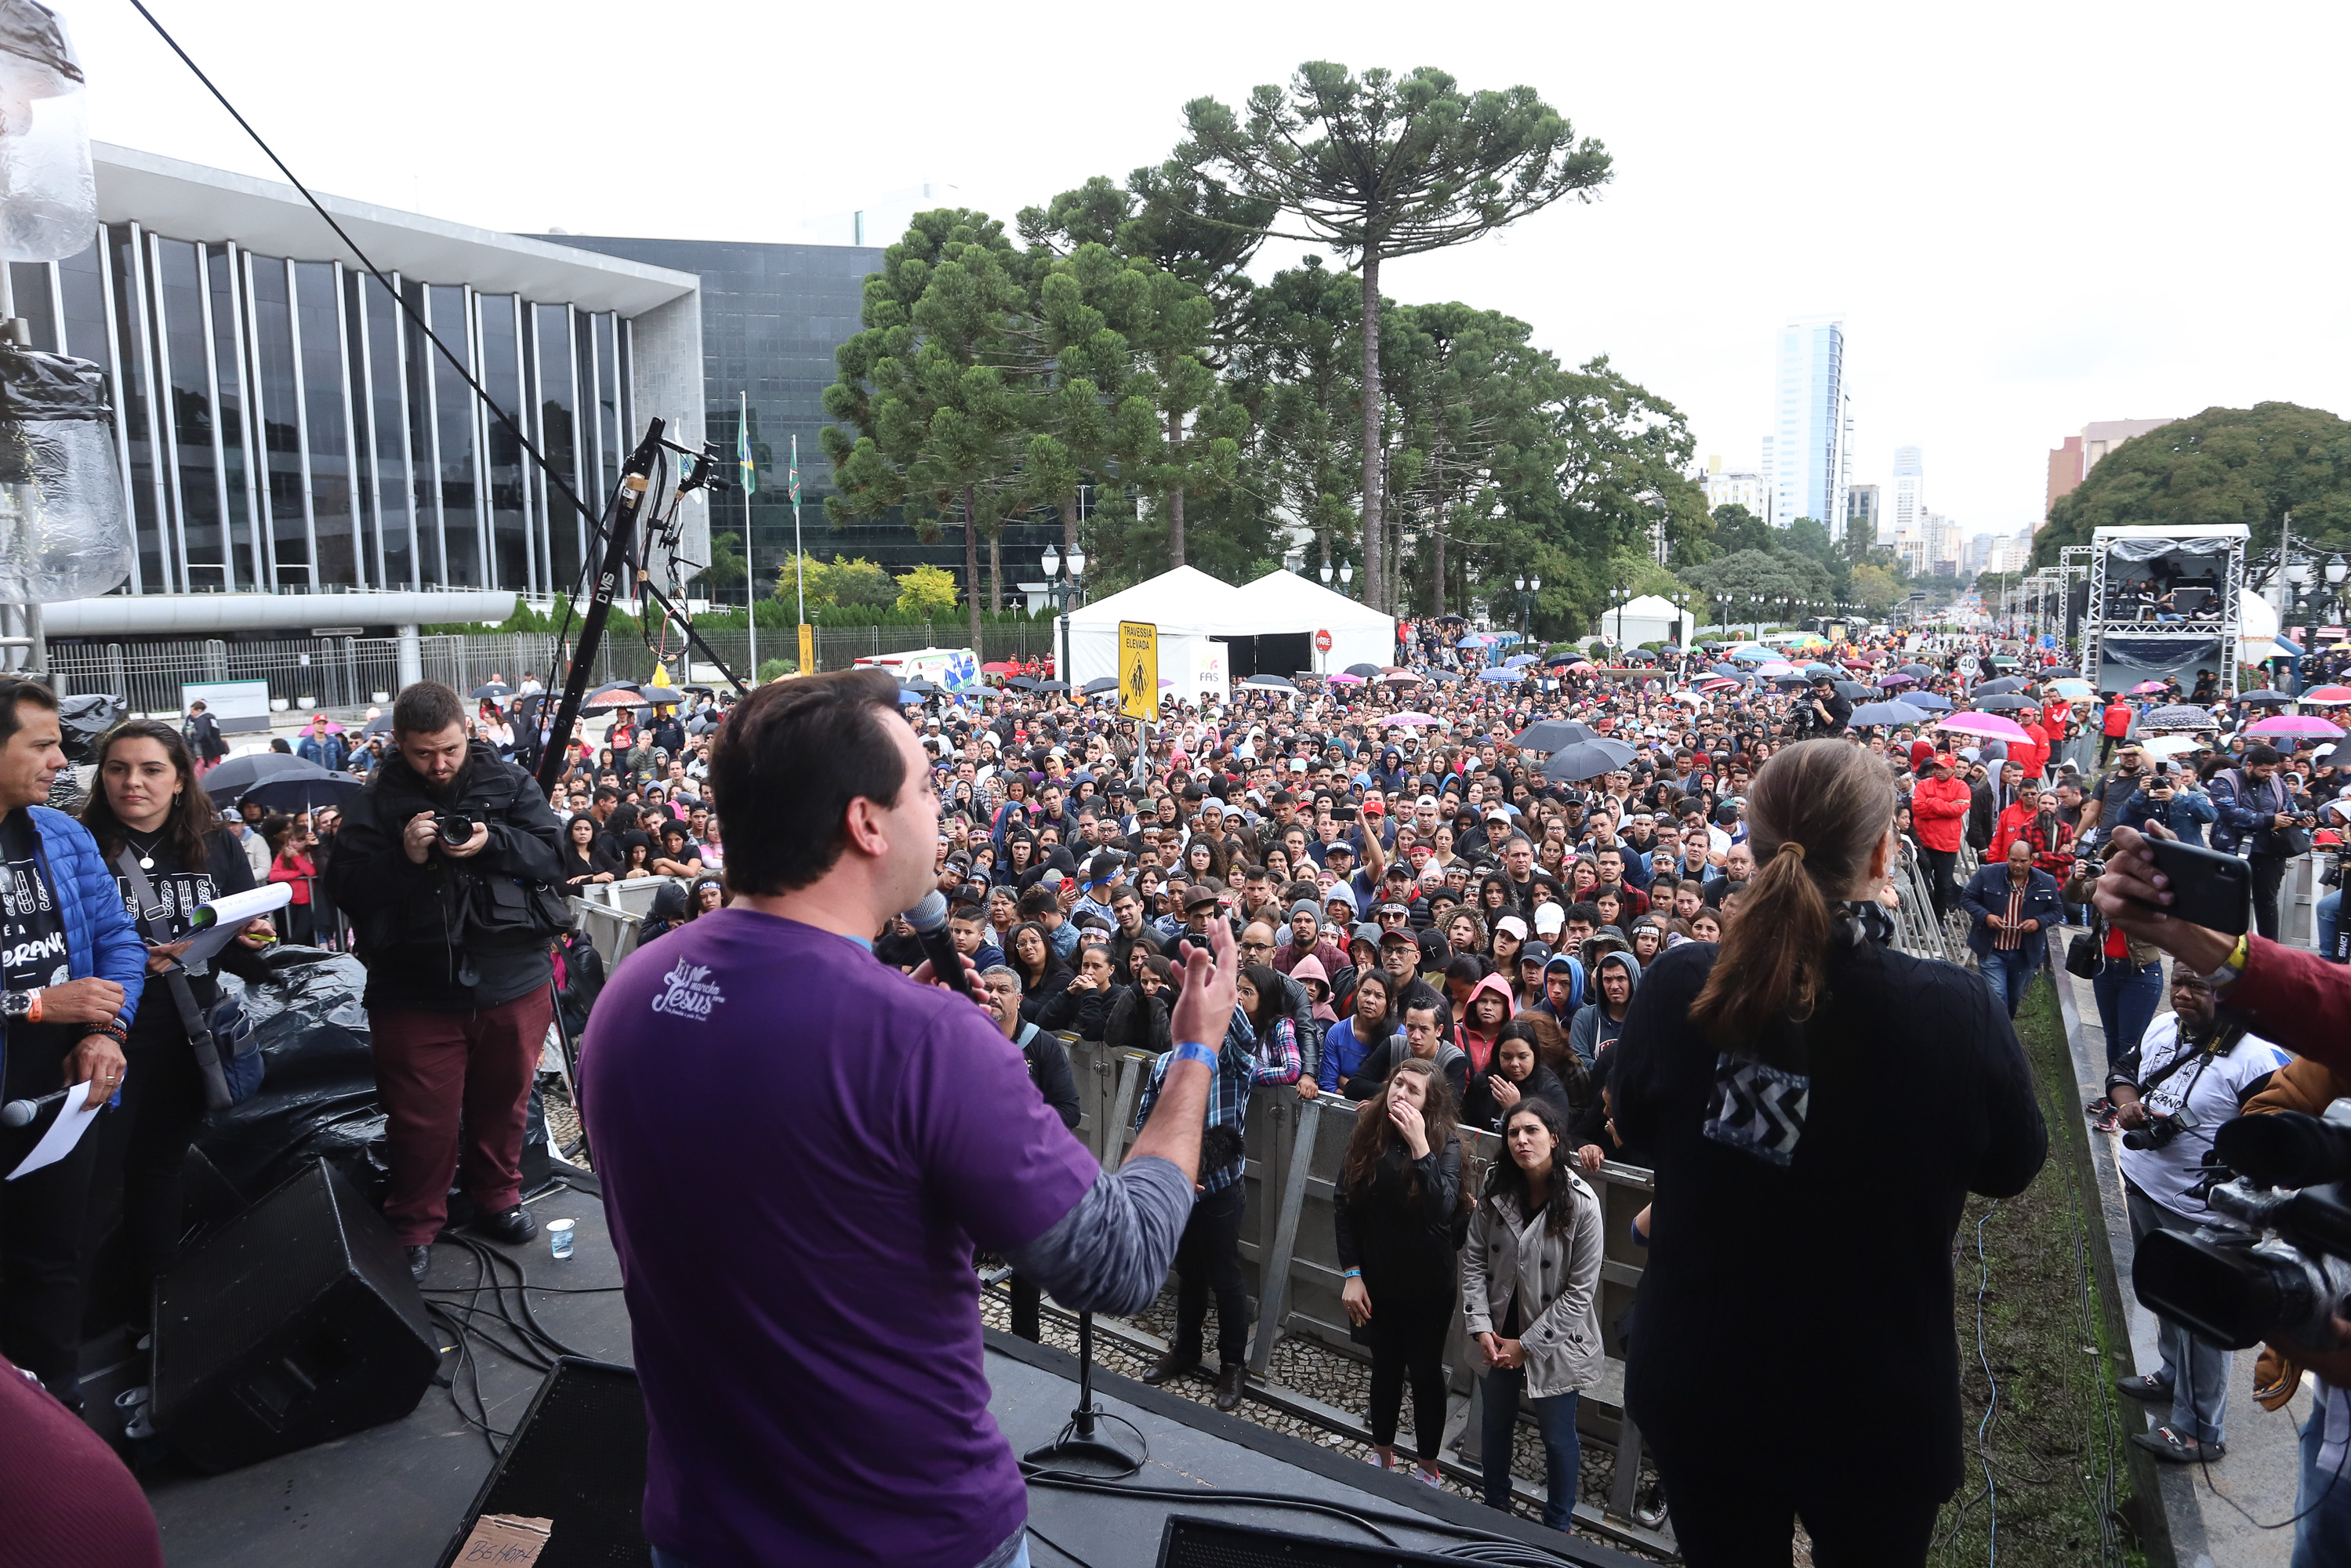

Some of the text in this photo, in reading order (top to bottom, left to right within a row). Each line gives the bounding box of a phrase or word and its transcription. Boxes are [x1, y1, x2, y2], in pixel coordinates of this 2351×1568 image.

[596, 572, 615, 604] DMS
[1123, 626, 1152, 639] TRAVESSIA
[1126, 637, 1150, 651] ELEVADA
[1316, 636, 1331, 646] PARE
[1961, 659, 1975, 670] 40
[1199, 672, 1219, 682] FAS
[3, 924, 27, 937] É A
[172, 924, 180, 934] A
[2338, 935, 2349, 958] DMS
[651, 971, 712, 1014] Jesus
[689, 980, 720, 996] marcha
[2208, 1036, 2221, 1052] Nikon
